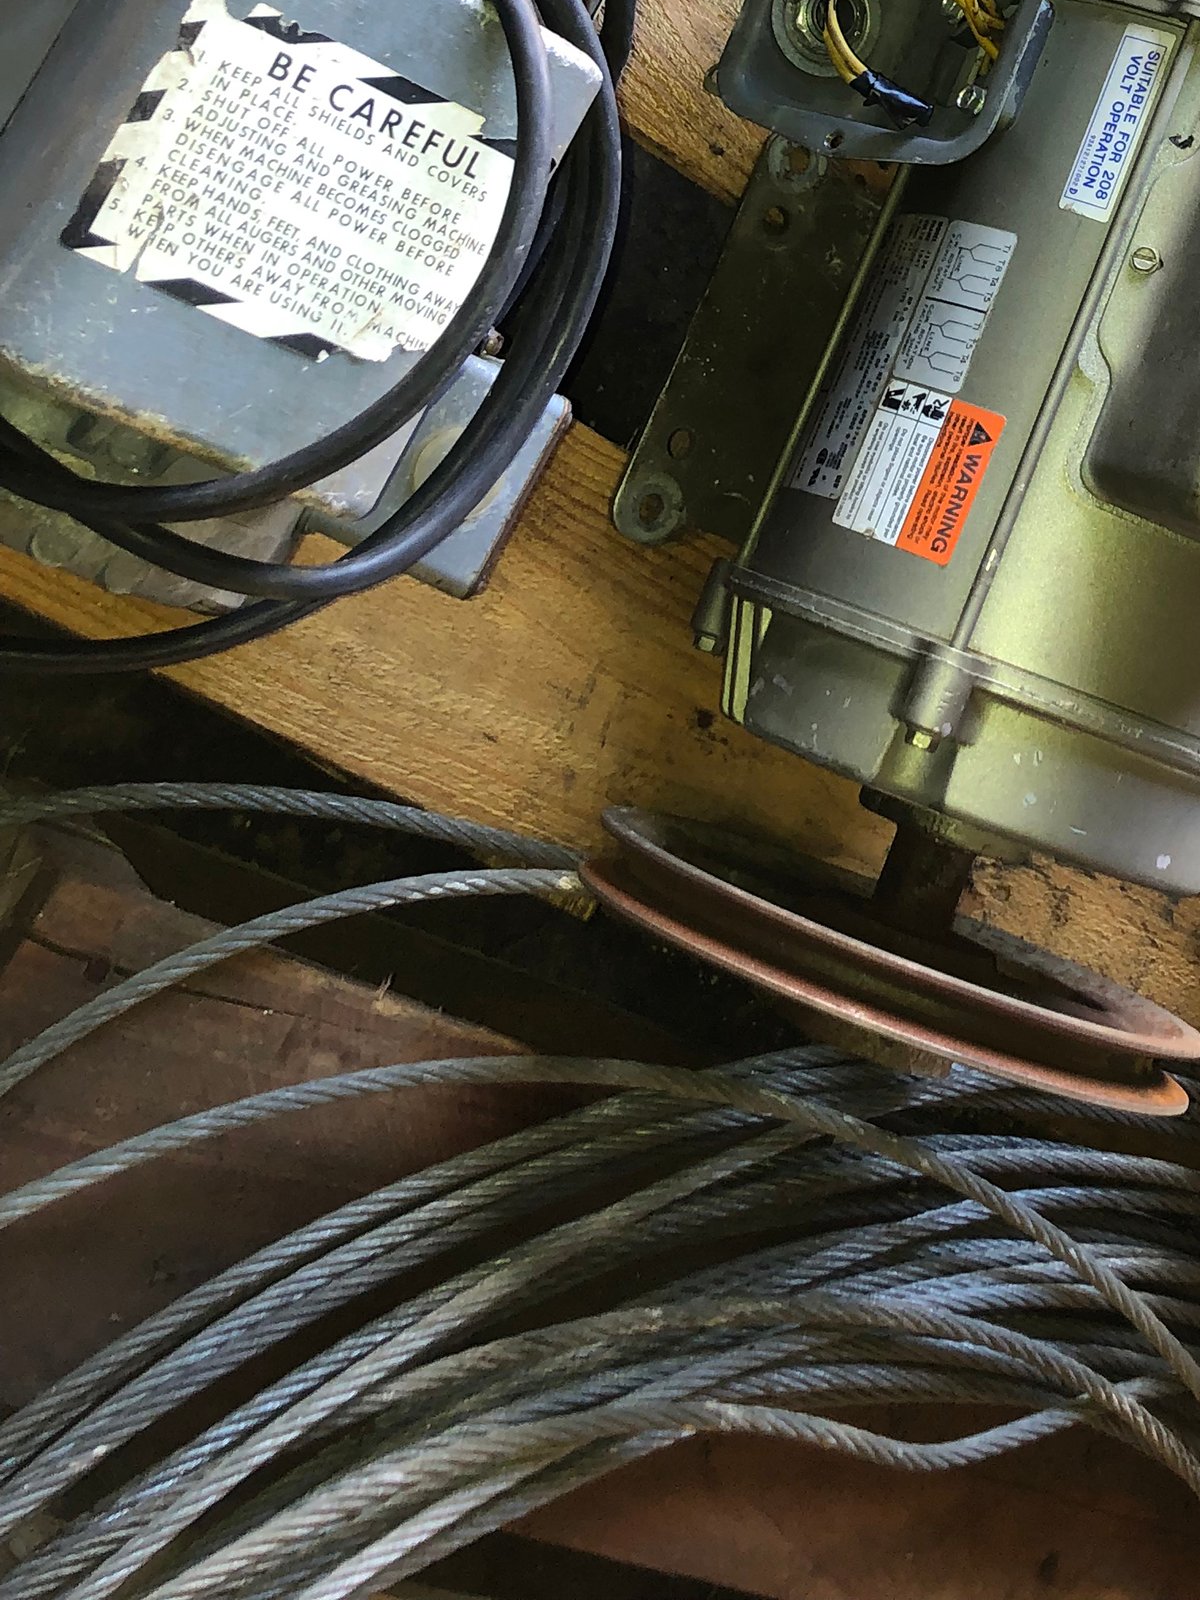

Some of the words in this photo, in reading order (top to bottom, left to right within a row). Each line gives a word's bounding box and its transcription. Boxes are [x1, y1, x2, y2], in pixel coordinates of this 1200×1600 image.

[209, 74, 231, 92] IN
[238, 87, 296, 125] PLACE.
[266, 51, 316, 93] BE
[328, 84, 479, 179] CAREFUL
[1119, 55, 1143, 94] VOLT
[1122, 50, 1161, 124] SUITABLE
[175, 77, 193, 93] 2.
[200, 89, 251, 119] SHUT
[256, 116, 290, 138] OFF
[295, 136, 324, 159] ALL
[332, 153, 393, 192] POWER
[400, 187, 461, 225] BEFORE
[191, 103, 287, 156] ADJUSTING
[292, 152, 330, 177] AND
[337, 173, 417, 220] GREASING
[196, 49, 207, 64] 1.
[217, 59, 262, 87] KEEP
[268, 85, 299, 109] ALL
[307, 104, 375, 146] SHIELDS
[381, 142, 419, 167] AND
[426, 164, 487, 202] COVERS
[1082, 100, 1125, 188] OPERATION
[1107, 130, 1130, 163] FOR
[161, 107, 175, 122] 3.
[184, 116, 235, 150] WHEN
[238, 144, 313, 188] MACHINE
[315, 182, 387, 225] BECOMES
[391, 219, 460, 259] CLOGGED
[167, 148, 265, 204] CLEANING.
[174, 132, 284, 193] DISENGAGE
[289, 189, 320, 212] ALL
[327, 207, 387, 245] POWER
[394, 239, 454, 276] BEFORE
[1094, 169, 1115, 200] 208
[132, 152, 153, 172] 4.
[156, 163, 199, 189] KEEP
[201, 183, 262, 224] HANDS,
[305, 235, 342, 259] AND
[346, 253, 420, 295] CLOTHING
[422, 290, 464, 317] AWAY
[140, 191, 198, 229] PARTS
[201, 220, 256, 256] WHEN
[259, 247, 281, 268] IN
[150, 178, 200, 210] FROM
[203, 204, 232, 226] ALL
[236, 220, 298, 256] AUGERS
[300, 250, 336, 273] AND
[339, 268, 386, 298] OTHER
[388, 290, 447, 325] MOVING
[993, 259, 1006, 272] T8
[106, 195, 128, 215] 5.
[131, 205, 176, 238] KEP
[179, 228, 247, 271] OTHERS
[249, 261, 306, 298] AWAY
[309, 289, 362, 325] FROM
[365, 315, 429, 356] MACHIN
[125, 222, 180, 258] WHEN
[184, 250, 225, 279] YOU
[228, 270, 265, 298] ARE
[267, 288, 324, 326] USING
[935, 252, 955, 292] ROTATION
[905, 327, 926, 370] ROTATION
[923, 330, 935, 351] LINE
[951, 370, 964, 382] T8
[929, 454, 982, 553] WARNING
